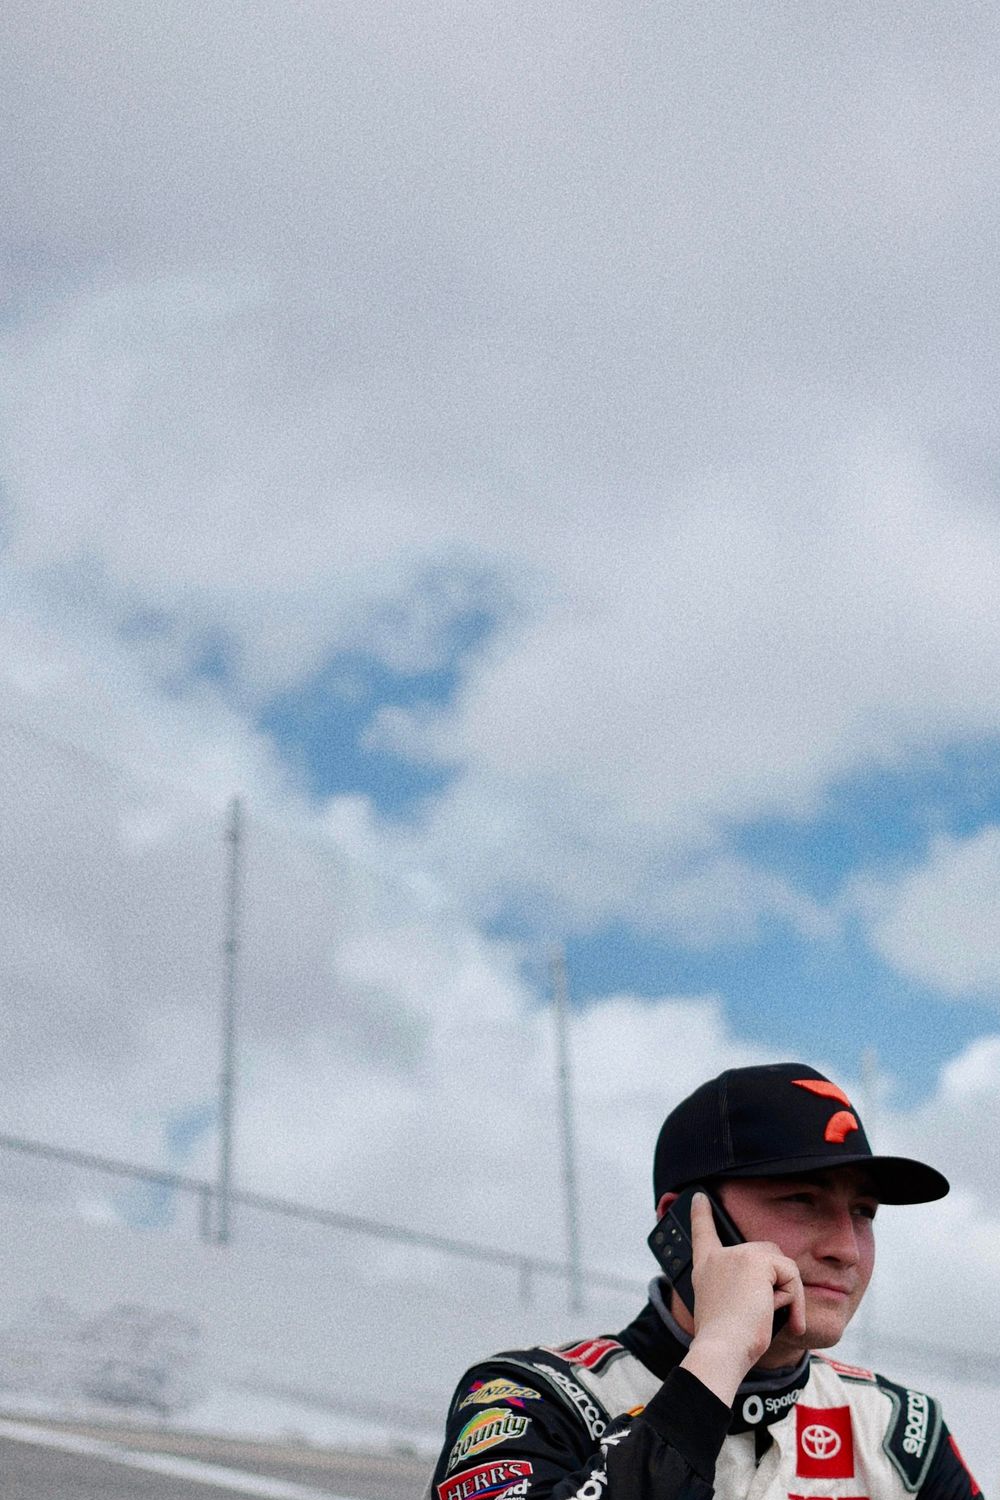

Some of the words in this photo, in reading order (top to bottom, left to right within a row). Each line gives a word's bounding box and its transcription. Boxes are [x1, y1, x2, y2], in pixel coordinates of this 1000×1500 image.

[461, 1385, 539, 1406] SUNOCO
[533, 1363, 607, 1440] sparco
[902, 1390, 927, 1457] sparc
[447, 1413, 529, 1473] Bounty
